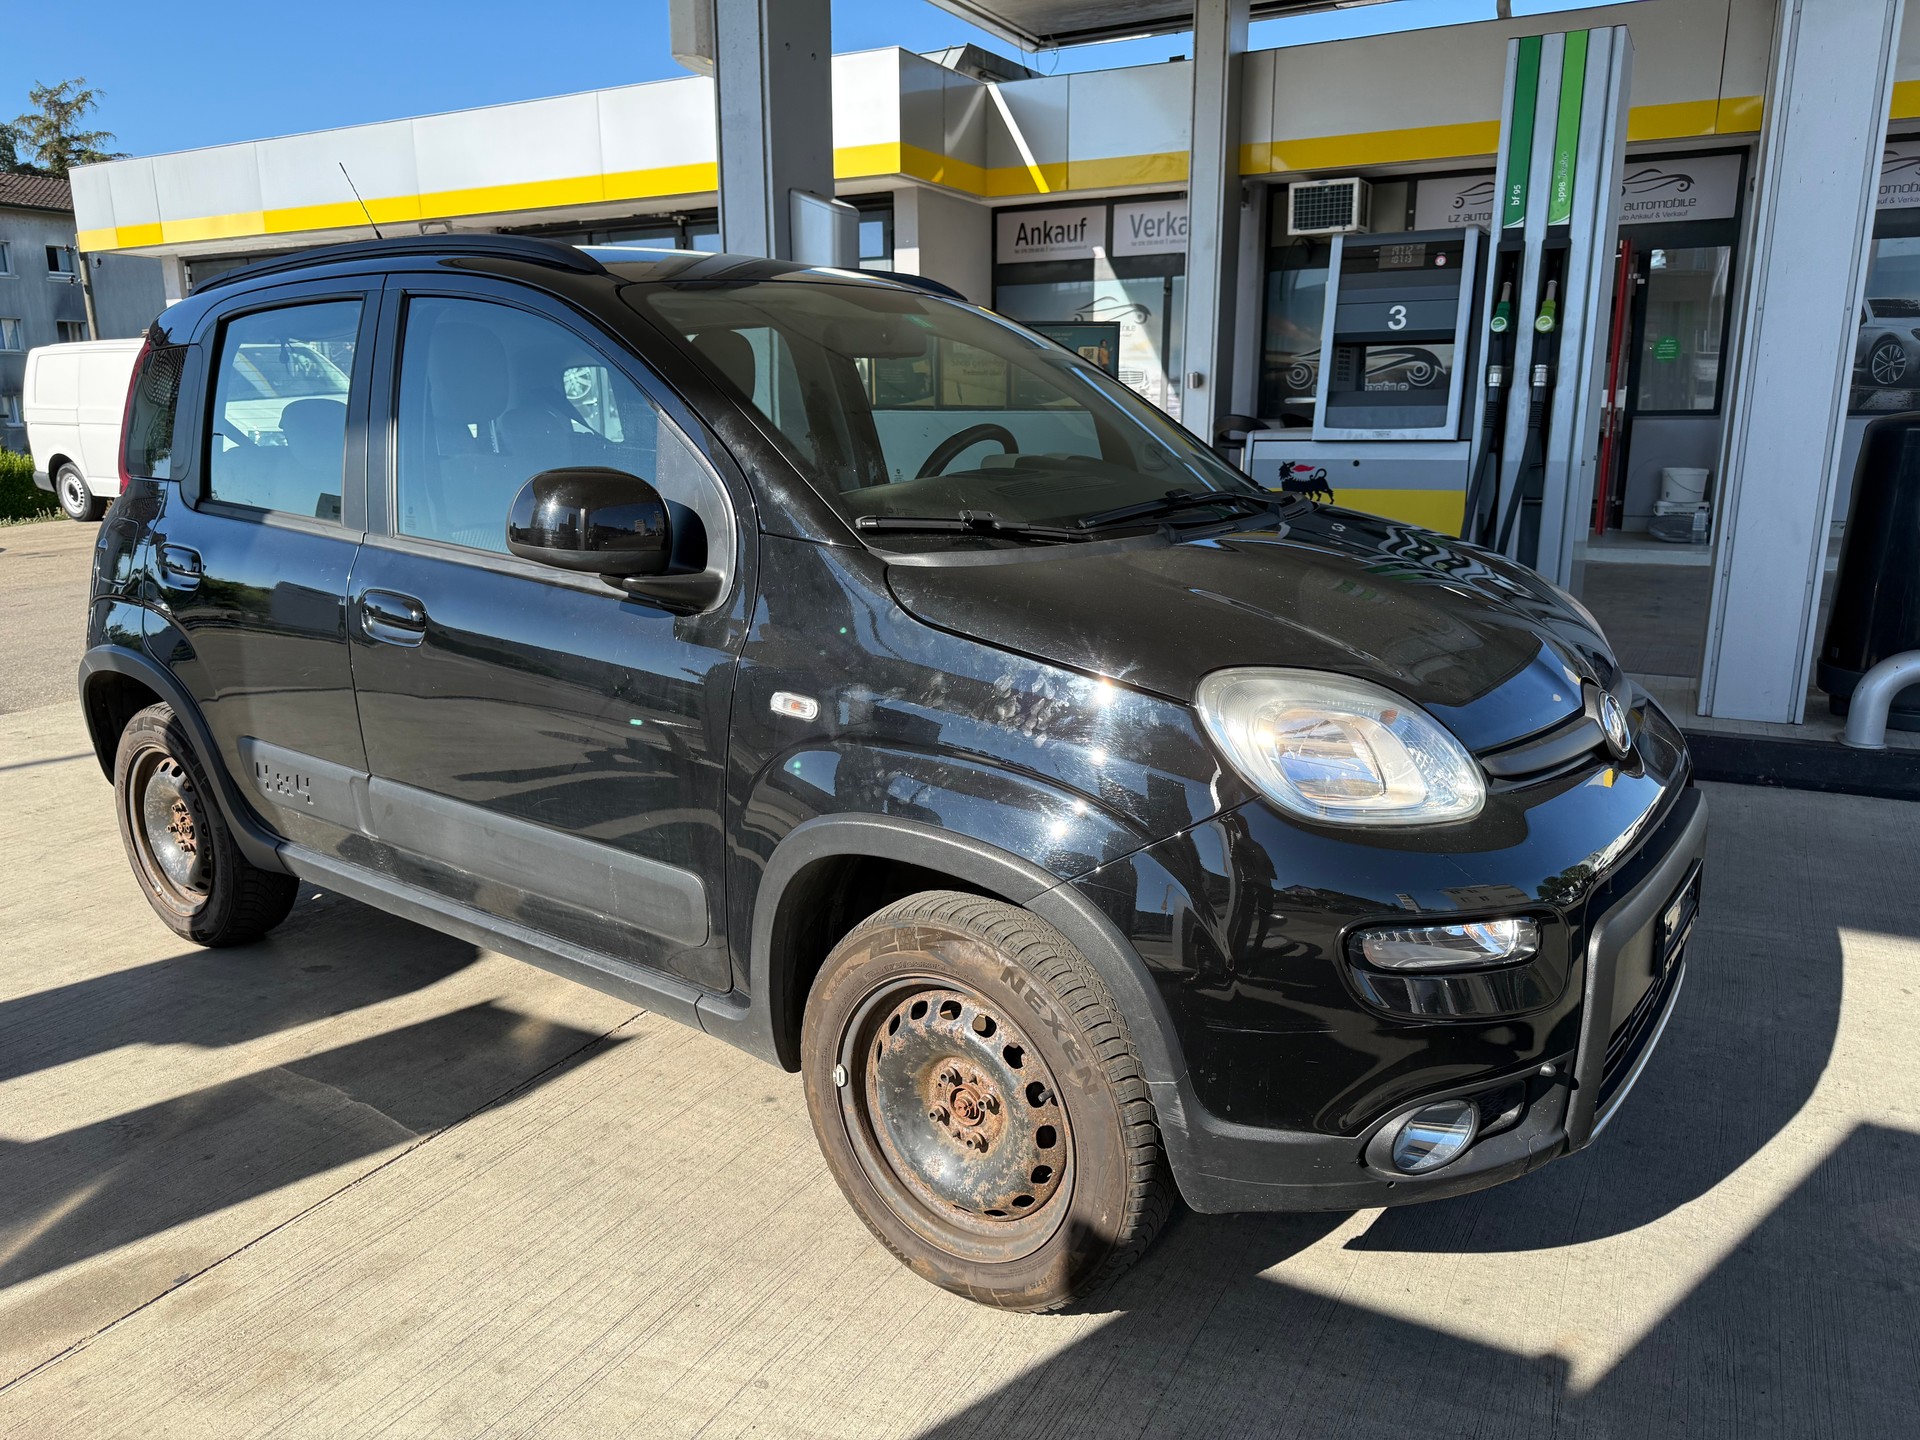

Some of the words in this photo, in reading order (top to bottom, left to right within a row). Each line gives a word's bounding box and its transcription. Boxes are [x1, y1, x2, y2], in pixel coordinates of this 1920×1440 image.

[1513, 184, 1521, 194] 95
[1511, 196, 1520, 205] bf
[1448, 214, 1461, 222] LZ
[1630, 212, 1653, 220] Ankauf
[1662, 210, 1688, 218] Verkauf
[1015, 217, 1087, 246] Ankauf
[1388, 305, 1406, 330] 3
[256, 762, 314, 805] 4x4
[1000, 967, 1099, 1095] NEXEN
